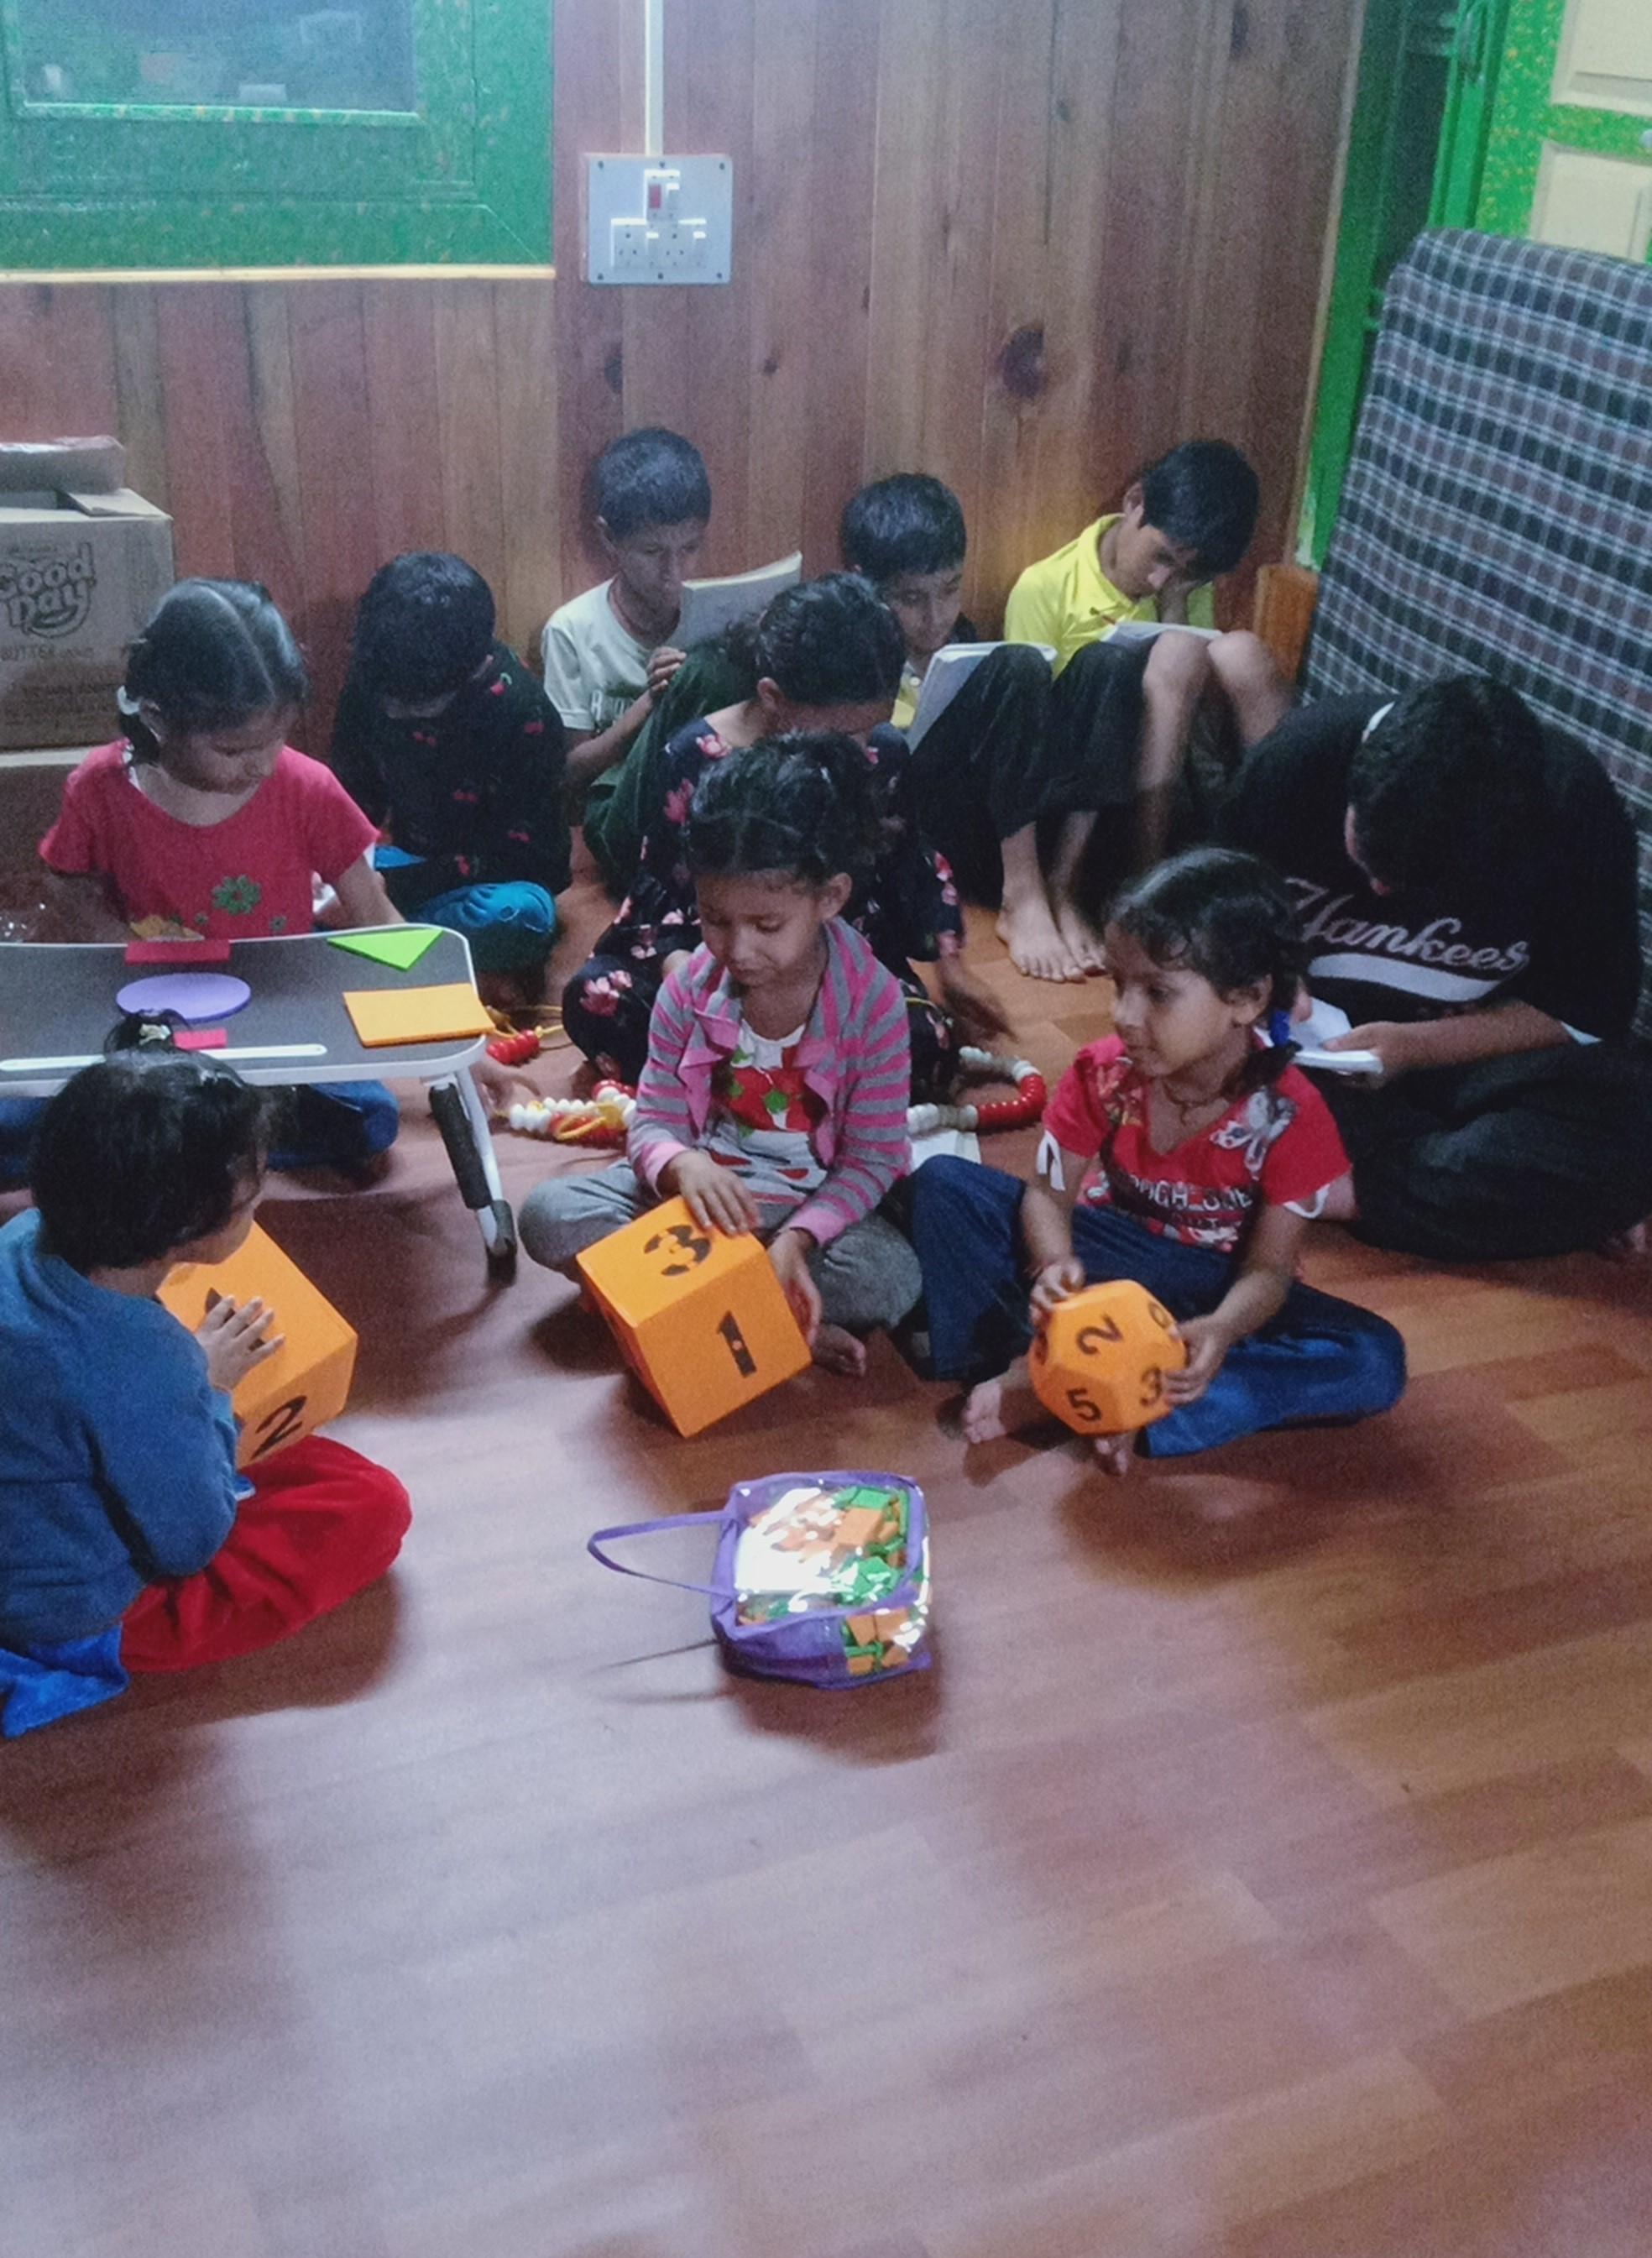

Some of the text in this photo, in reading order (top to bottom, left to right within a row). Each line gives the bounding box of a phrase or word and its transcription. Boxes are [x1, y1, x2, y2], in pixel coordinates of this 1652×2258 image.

[1285, 878, 1530, 971] Yankees
[644, 1224, 713, 1277] 3
[717, 1309, 757, 1378] 1
[251, 1395, 307, 1461] 2
[1066, 1388, 1102, 1422] 5
